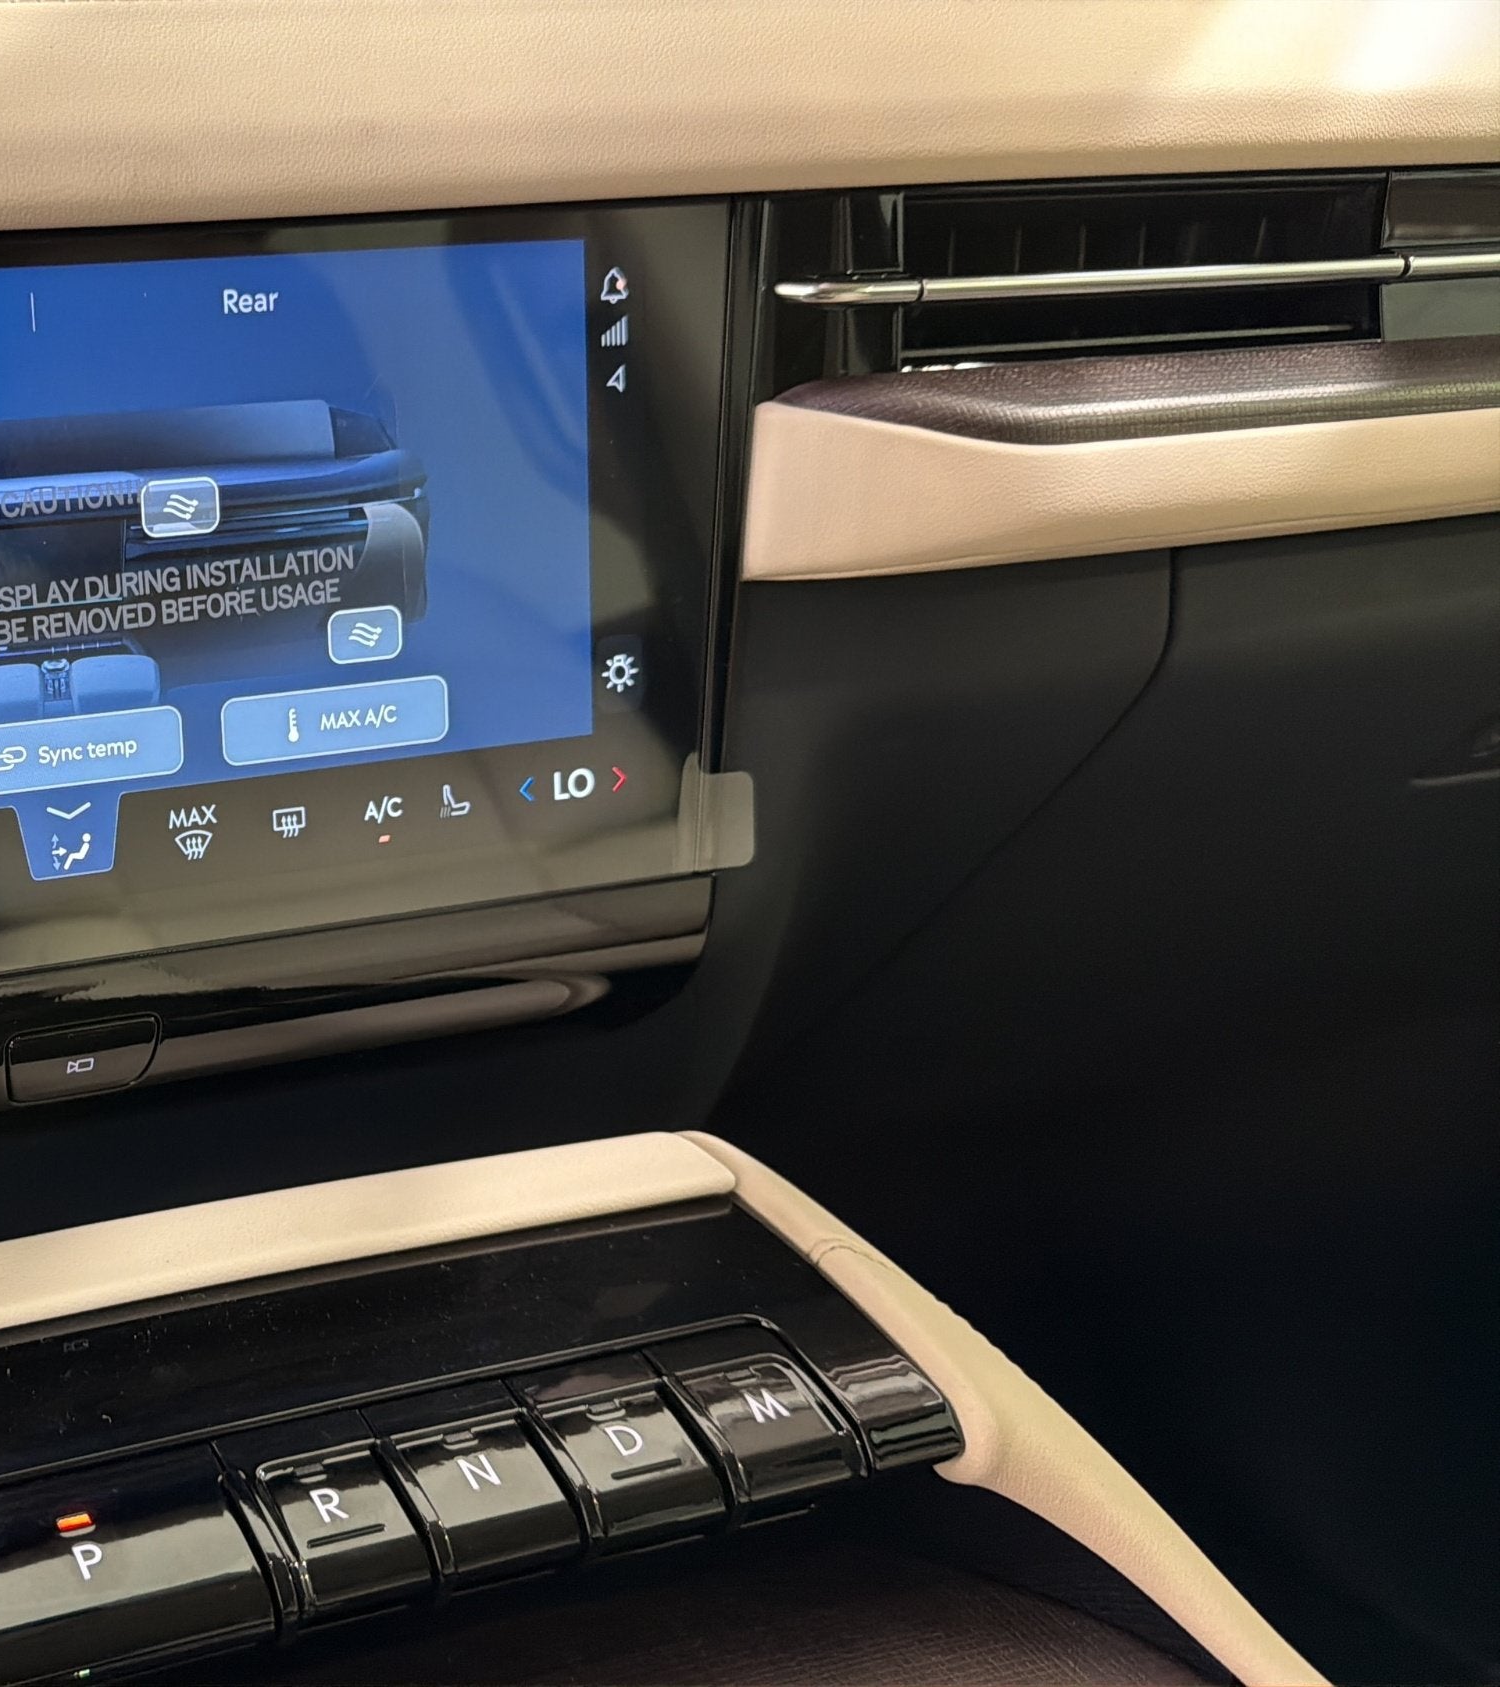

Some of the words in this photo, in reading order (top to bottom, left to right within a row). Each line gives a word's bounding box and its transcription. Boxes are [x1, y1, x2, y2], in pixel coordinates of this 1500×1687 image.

[222, 288, 279, 315] Rear
[84, 566, 181, 601] DURING
[186, 545, 355, 590] INSTALLATION
[33, 603, 156, 640] REMOVED
[161, 587, 257, 625] BEFORE
[261, 577, 342, 612] USAGE
[320, 712, 361, 731] MAX
[366, 705, 398, 727] A/C
[37, 746, 83, 768] Sync
[87, 738, 138, 764] temp
[553, 768, 596, 802] LO
[168, 803, 218, 831] MAX
[364, 796, 404, 822] A/C
[749, 1391, 791, 1424] M
[604, 1424, 644, 1457] D
[457, 1454, 501, 1491] N
[309, 1488, 350, 1524] R
[71, 1542, 103, 1581] P
